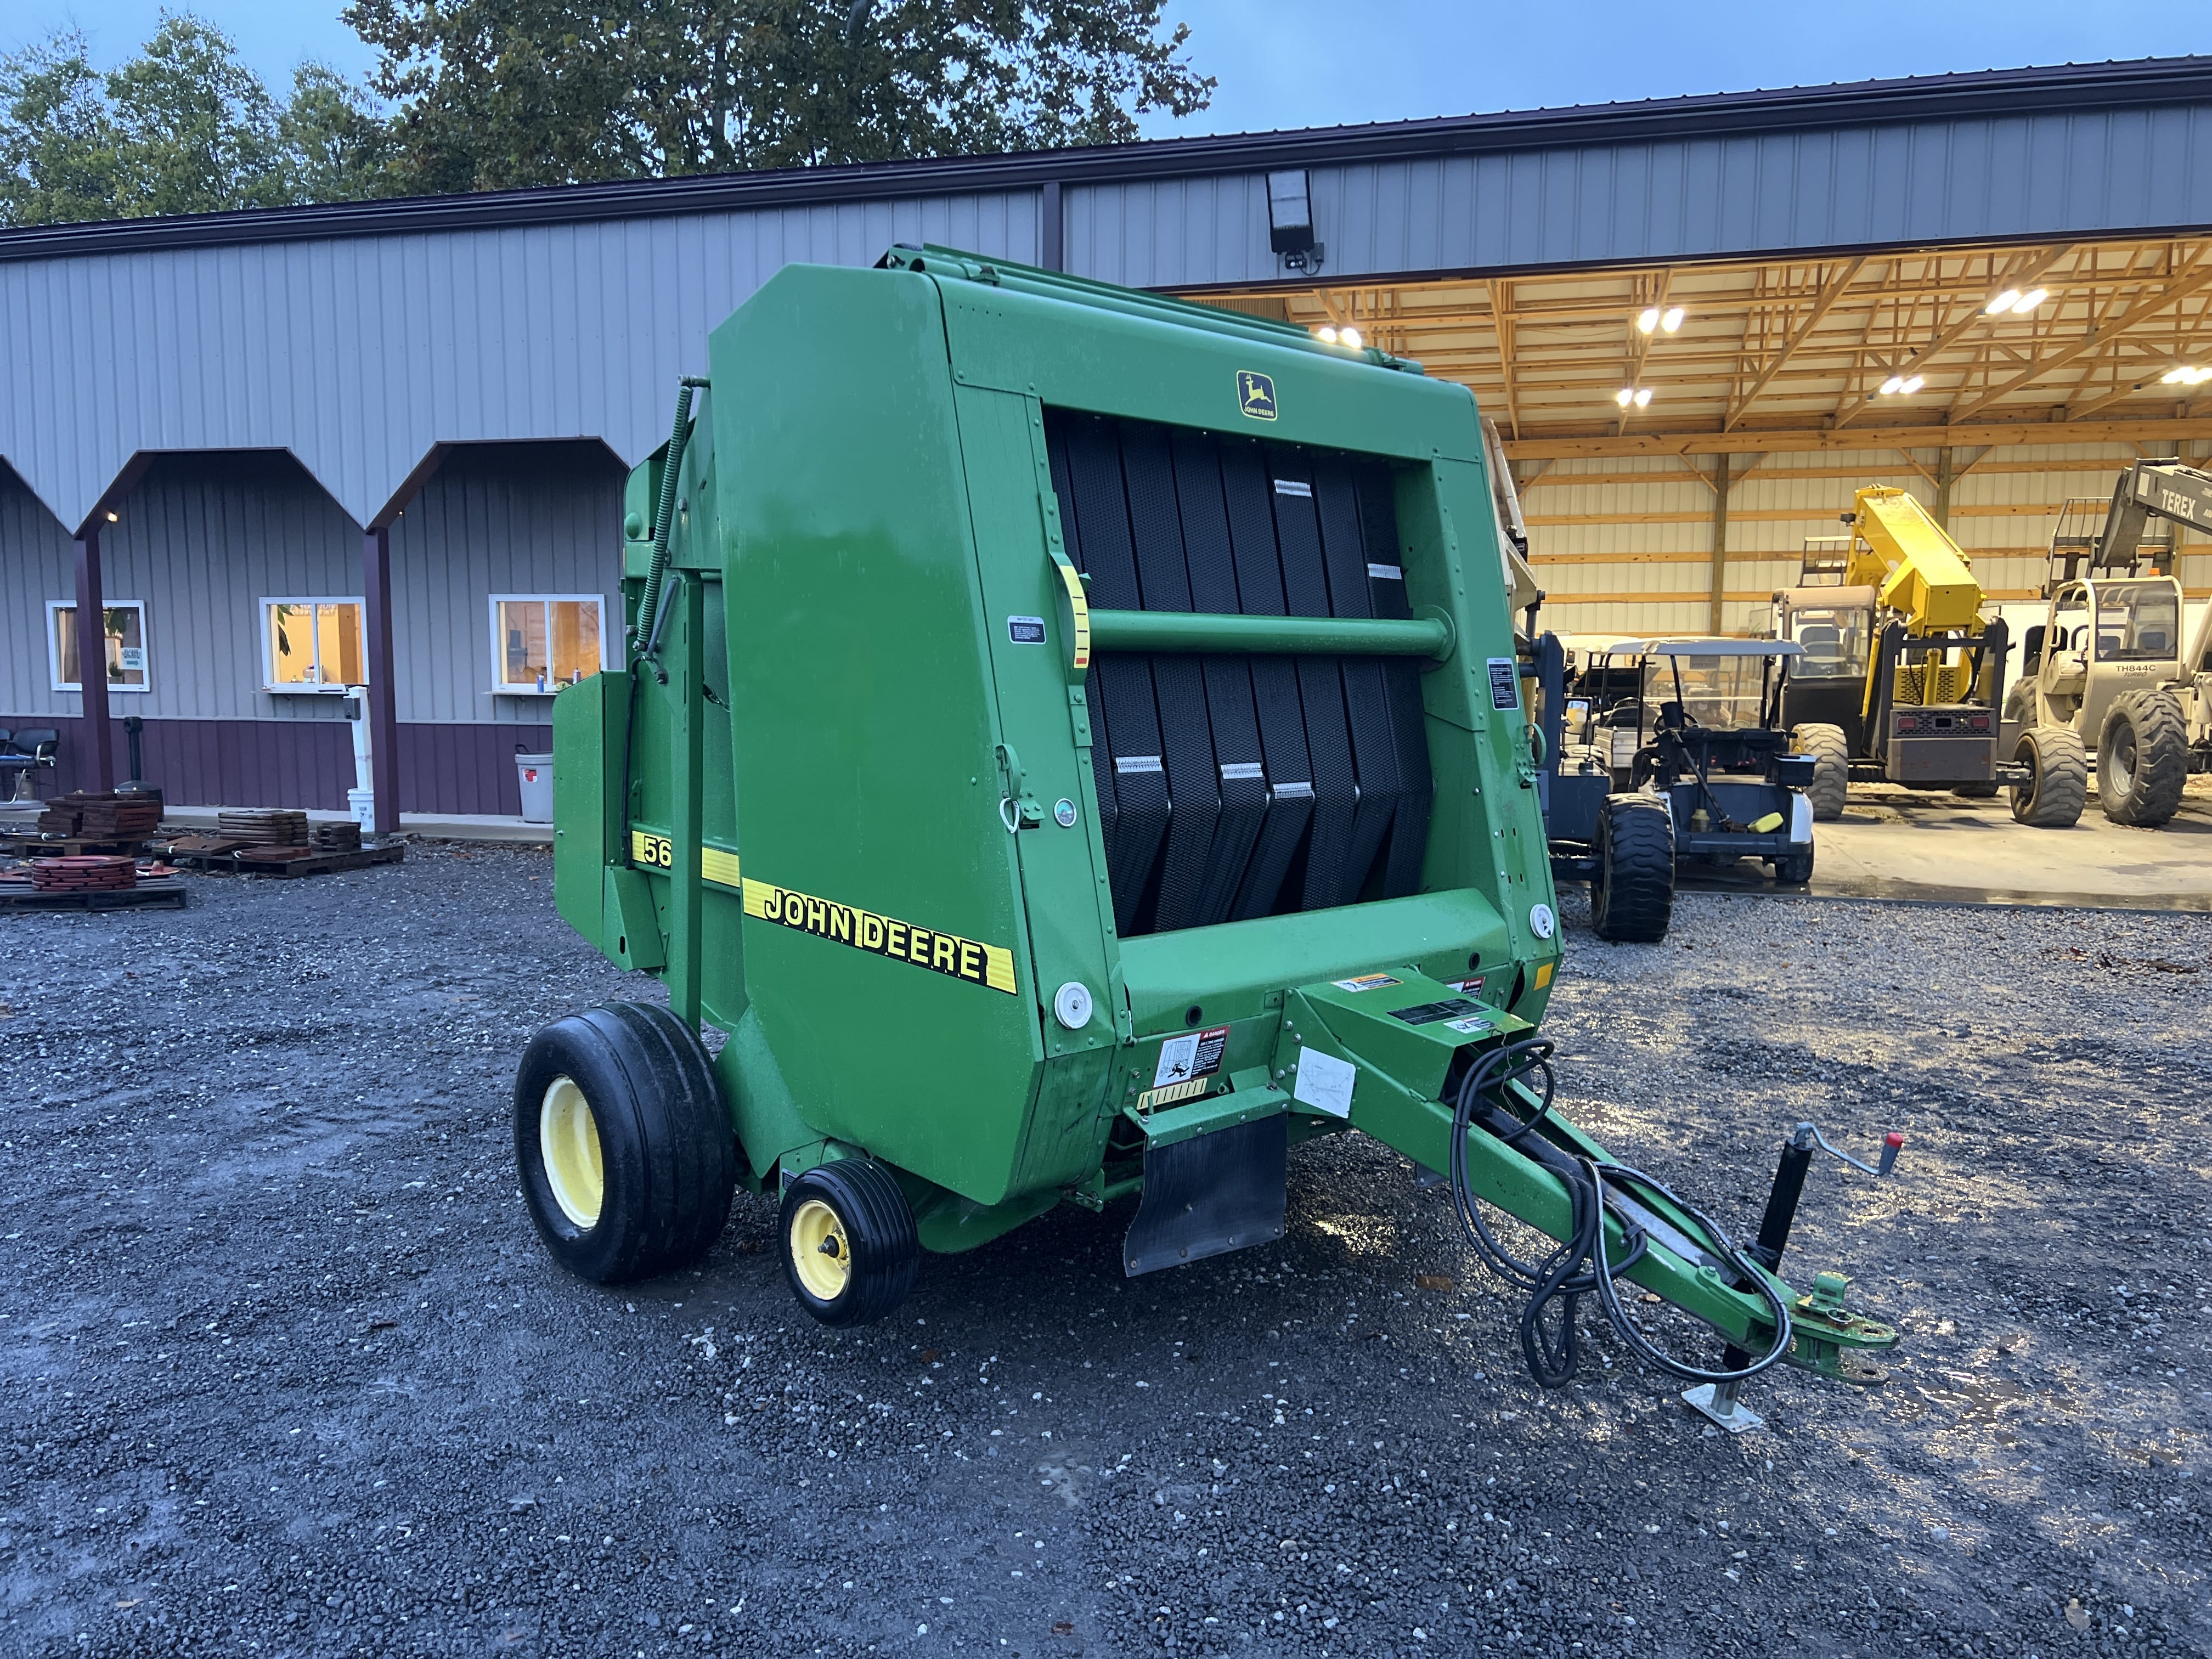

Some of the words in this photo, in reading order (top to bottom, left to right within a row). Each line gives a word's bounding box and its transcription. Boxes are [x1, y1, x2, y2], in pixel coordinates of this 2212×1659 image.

[2162, 488, 2196, 520] TEREX
[764, 889, 853, 941] JOHN
[862, 914, 982, 980] DEERE
